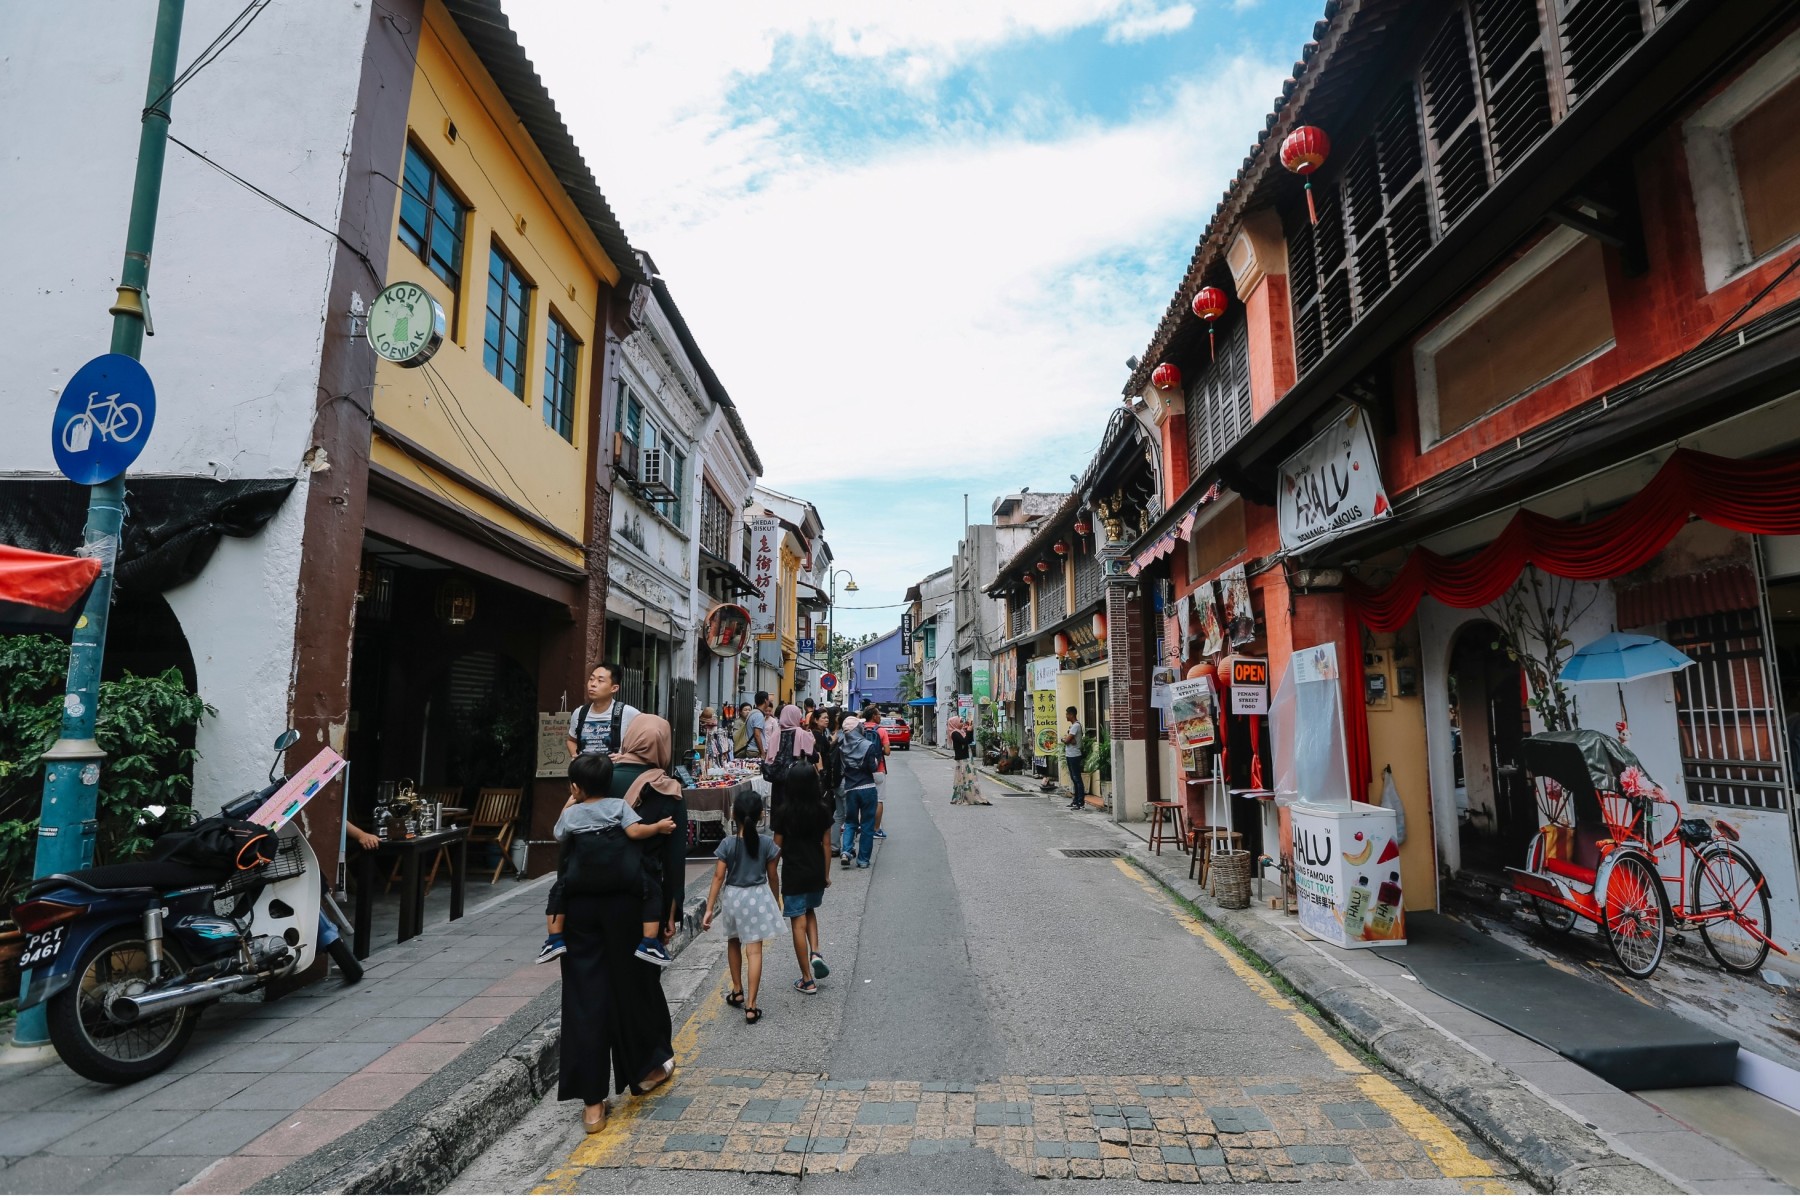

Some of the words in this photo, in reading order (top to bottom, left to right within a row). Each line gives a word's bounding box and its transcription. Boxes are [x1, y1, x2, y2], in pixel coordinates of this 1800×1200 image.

[384, 287, 423, 305] KOPI
[376, 330, 425, 358] LOEWAK
[1295, 451, 1351, 530] HALU
[801, 639, 812, 648] 19
[1235, 664, 1265, 681] OPEN
[1292, 824, 1332, 867] HALU
[1306, 868, 1334, 885] FAMOUS
[1315, 881, 1334, 897] TRY!
[1348, 890, 1362, 918] HALU
[29, 926, 64, 949] PCT
[20, 941, 61, 966] 9461
